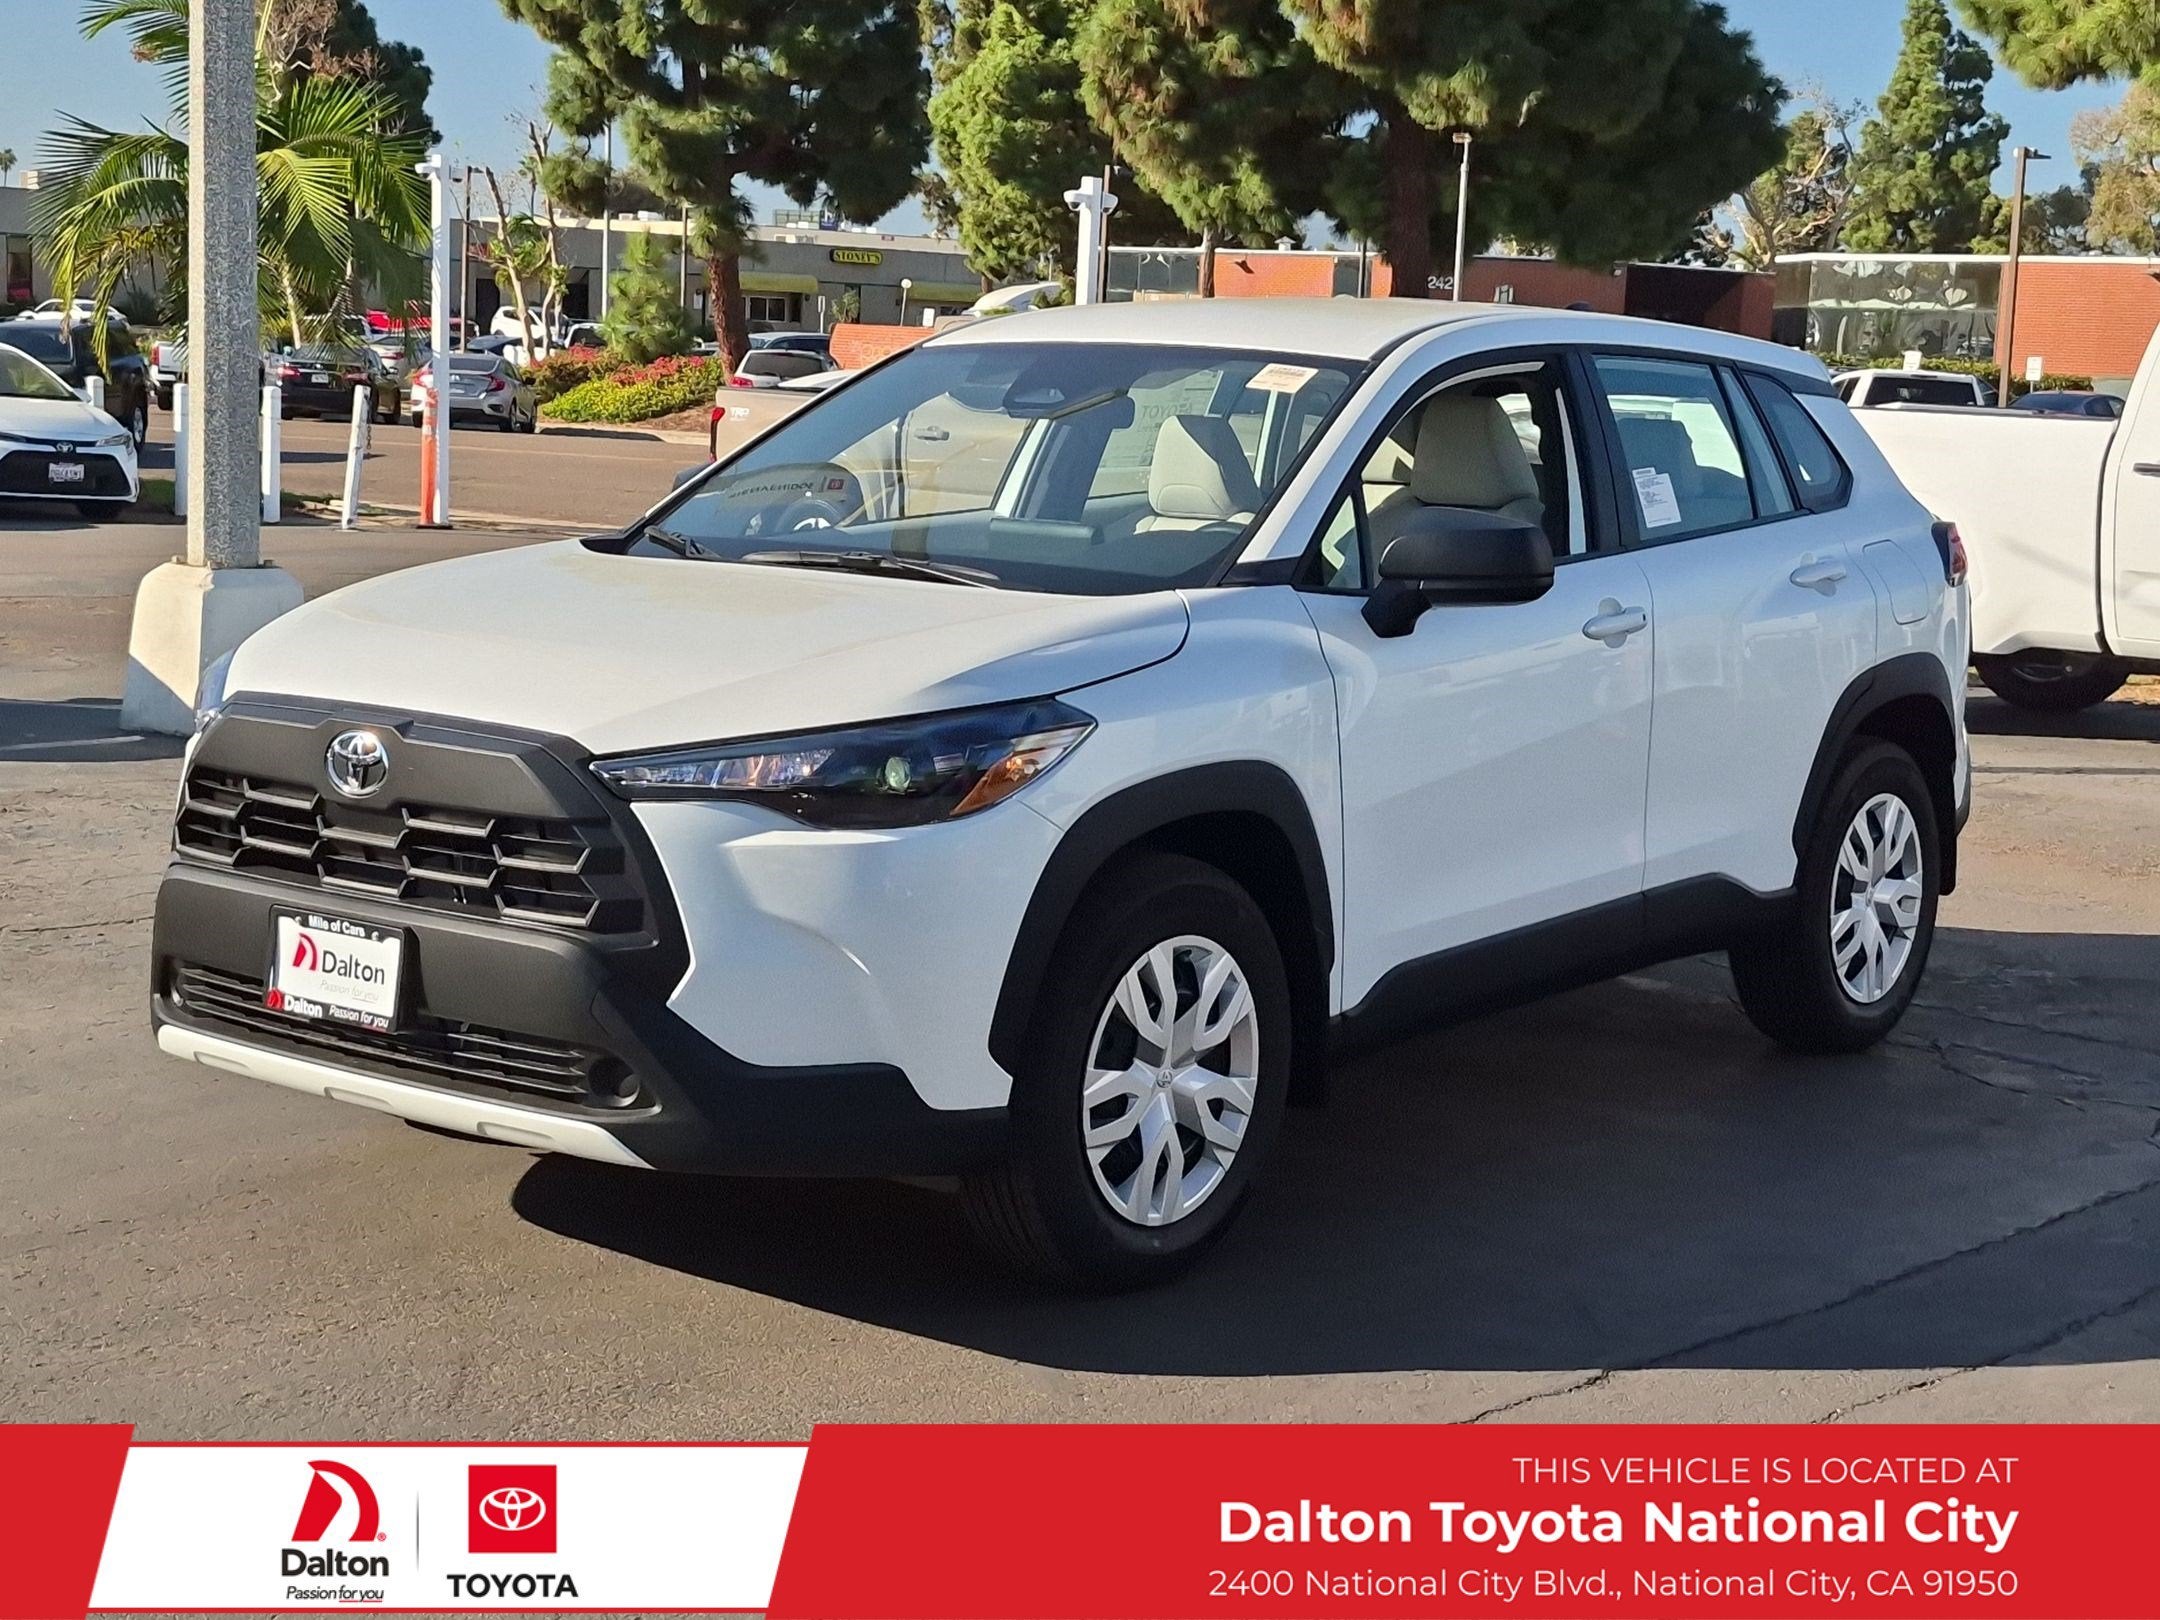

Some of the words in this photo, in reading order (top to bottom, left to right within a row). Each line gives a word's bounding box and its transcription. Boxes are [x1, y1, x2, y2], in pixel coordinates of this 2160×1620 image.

[308, 915, 329, 930] Mile
[330, 920, 341, 932] of
[342, 920, 366, 938] Cars
[322, 949, 385, 985] Dalton
[320, 979, 350, 996] Passion
[284, 994, 323, 1018] Dalton
[328, 1004, 360, 1022] Passion
[359, 1010, 373, 1024] for
[373, 1015, 390, 1028] you
